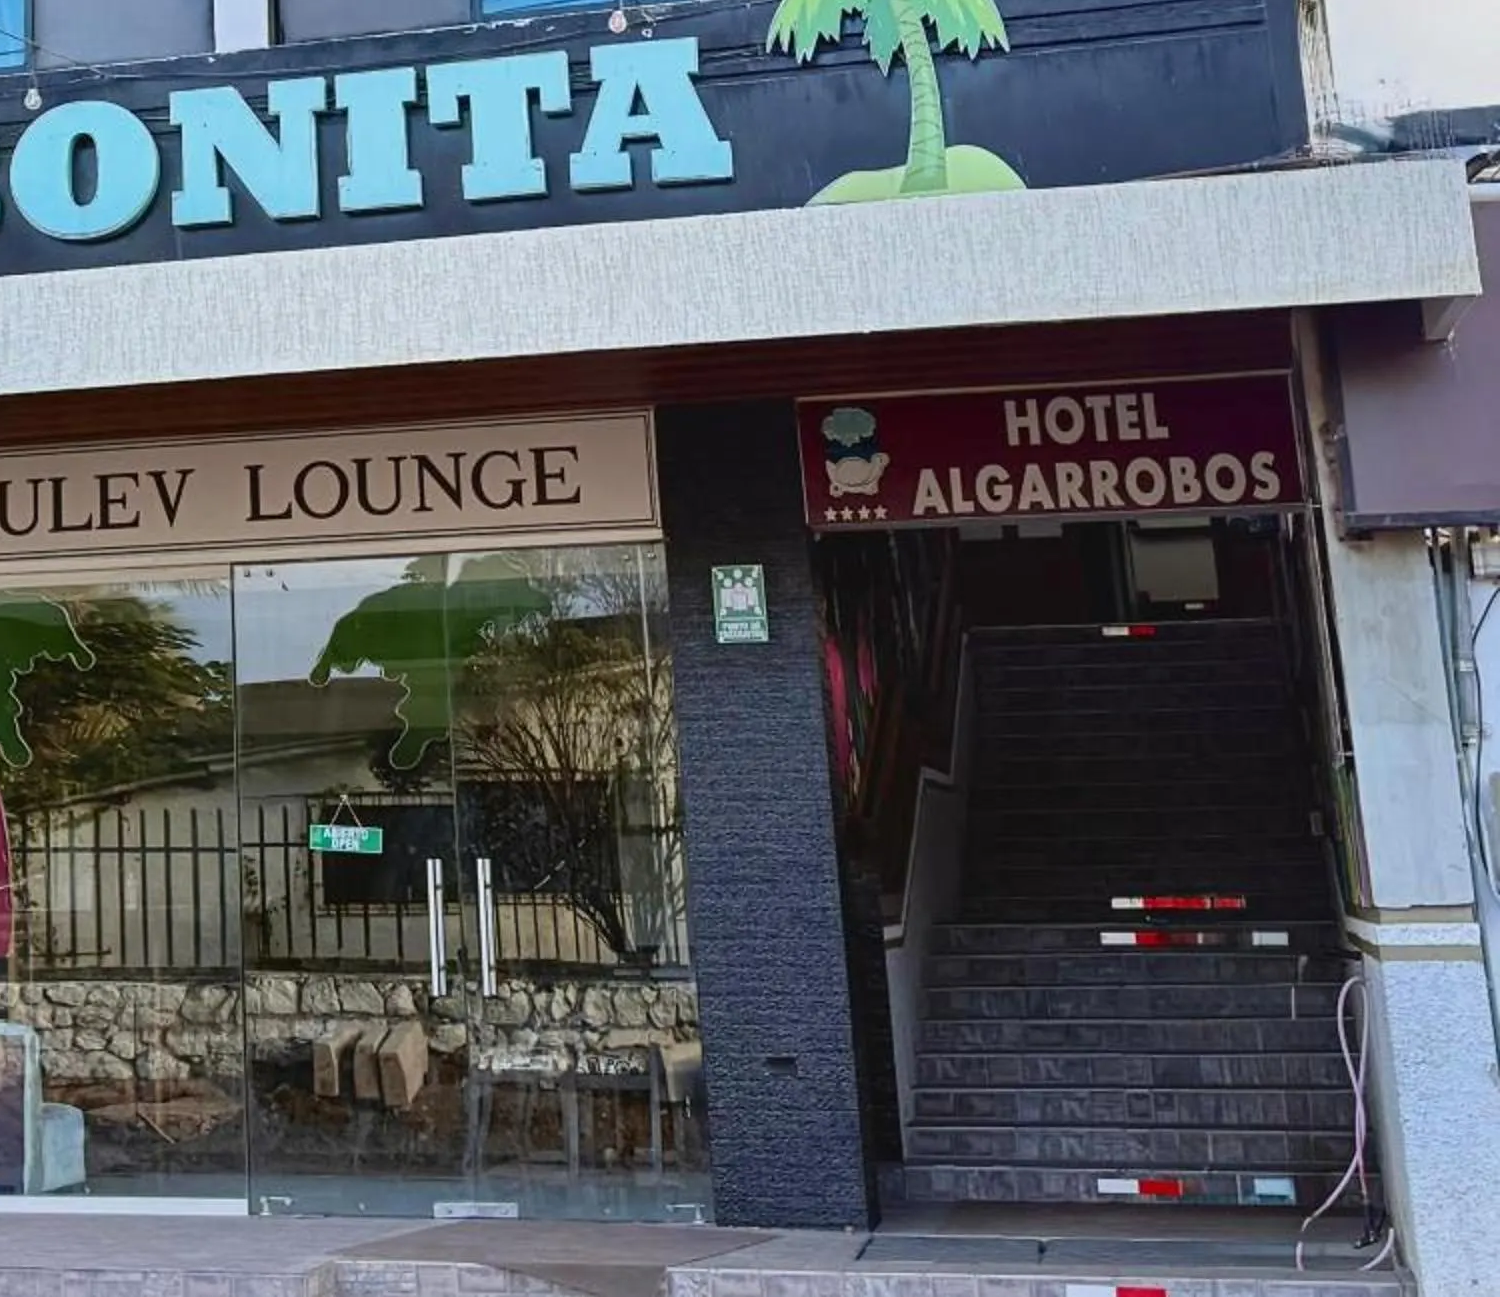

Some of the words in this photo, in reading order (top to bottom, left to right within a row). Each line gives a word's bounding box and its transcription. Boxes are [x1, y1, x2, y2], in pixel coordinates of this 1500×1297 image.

[1004, 392, 1169, 446] HOTEL
[244, 445, 582, 522] LOUNGE
[913, 450, 1281, 516] ALGARROBOS
